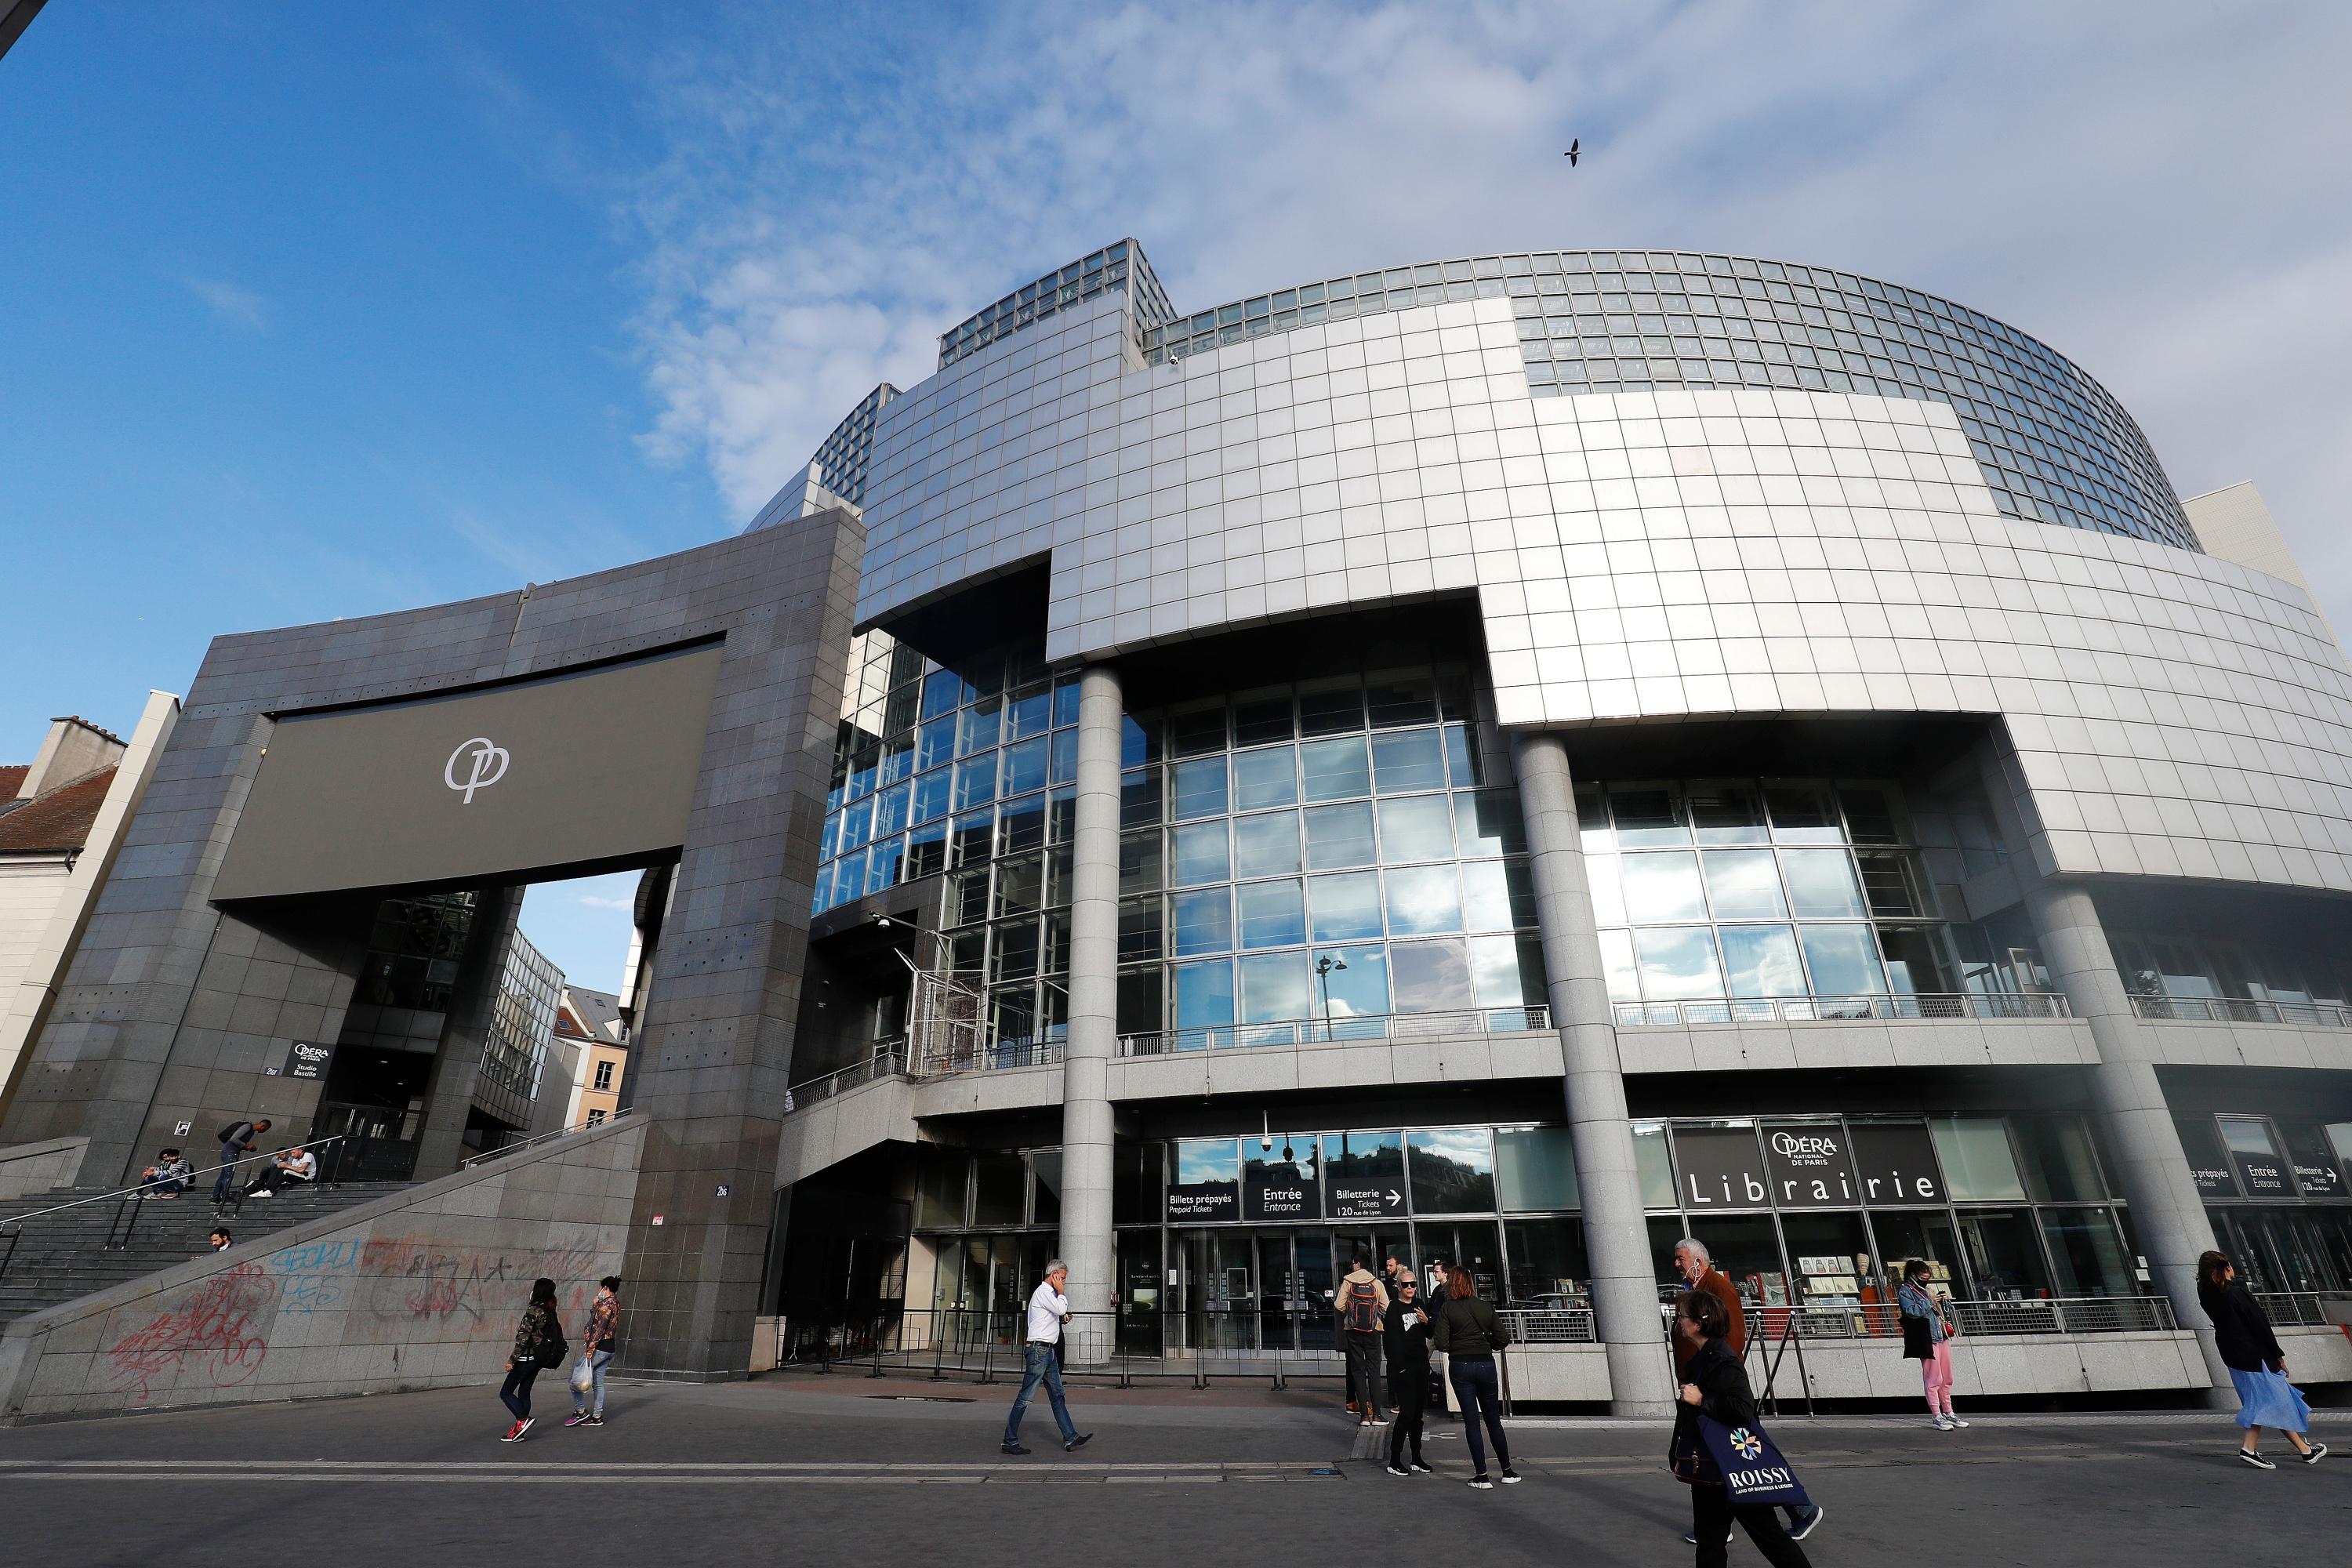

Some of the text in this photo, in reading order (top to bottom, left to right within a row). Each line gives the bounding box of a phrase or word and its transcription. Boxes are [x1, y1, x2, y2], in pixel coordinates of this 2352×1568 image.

[1772, 1132, 1838, 1158] OPÉRA
[2198, 1168, 2229, 1180] prépayés
[2247, 1164, 2279, 1177] Entrée
[2294, 1165, 2324, 1175] Billetterie
[1690, 1171, 1934, 1203] Librairie
[2252, 1178, 2281, 1189] Entrance
[2301, 1181, 2313, 1191] 120
[717, 1185, 728, 1196] 2bis
[1263, 1187, 1302, 1201] Entrée
[1336, 1189, 1380, 1200] Billetterie
[1170, 1193, 1232, 1206] Billets prépayés
[1169, 1206, 1192, 1215] Prepaid
[1264, 1201, 1301, 1212] Entrance
[1338, 1207, 1353, 1216] 120
[1728, 1467, 1791, 1488] ROISSY
